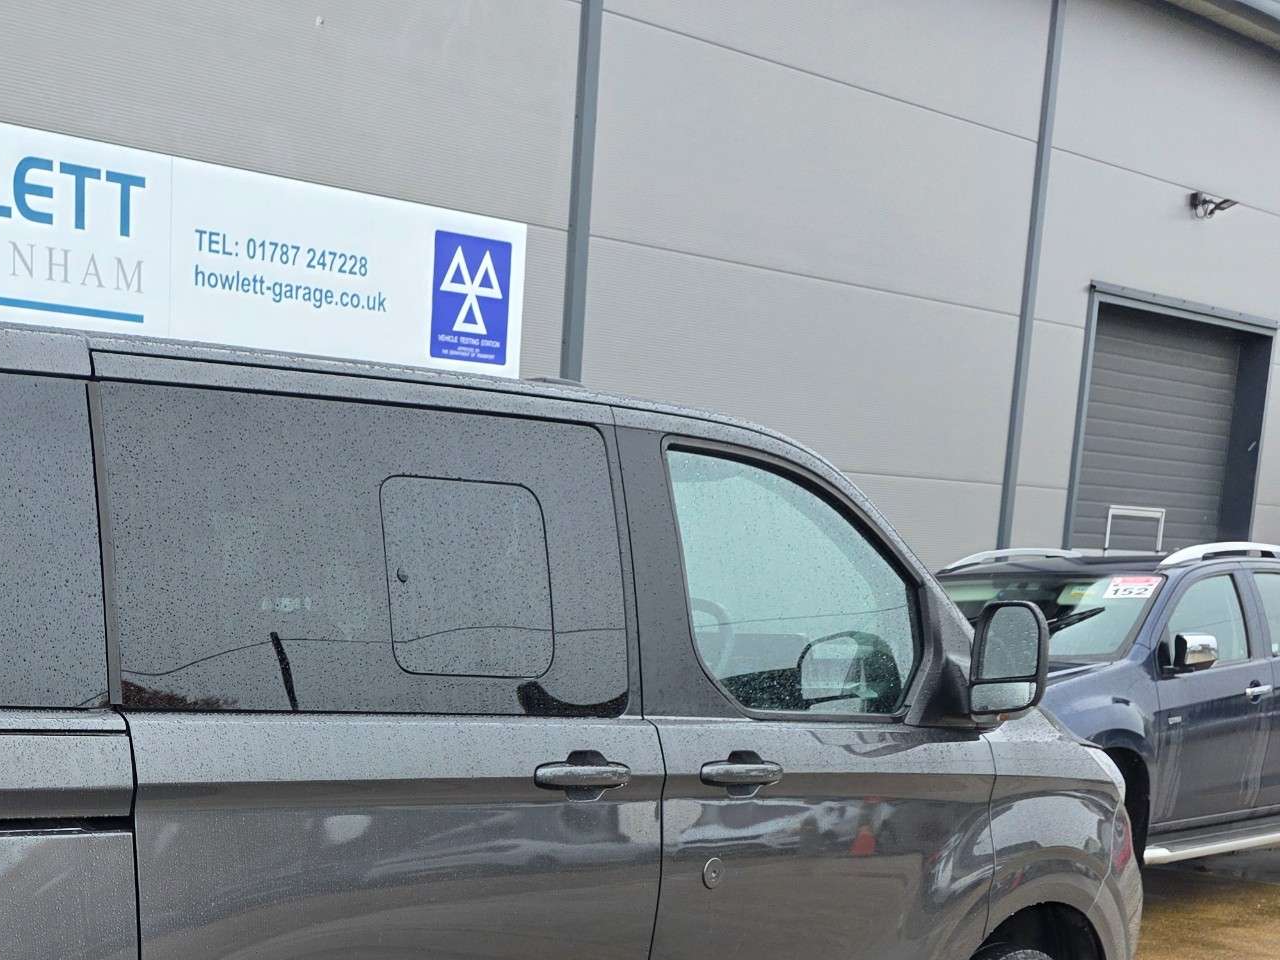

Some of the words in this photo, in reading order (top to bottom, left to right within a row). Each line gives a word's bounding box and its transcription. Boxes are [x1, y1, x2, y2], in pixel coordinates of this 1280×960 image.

[194, 229, 239, 257] TEL:
[246, 237, 300, 266] 01787
[306, 248, 368, 277] 247228
[194, 264, 387, 312] howlett-garage.co.uk
